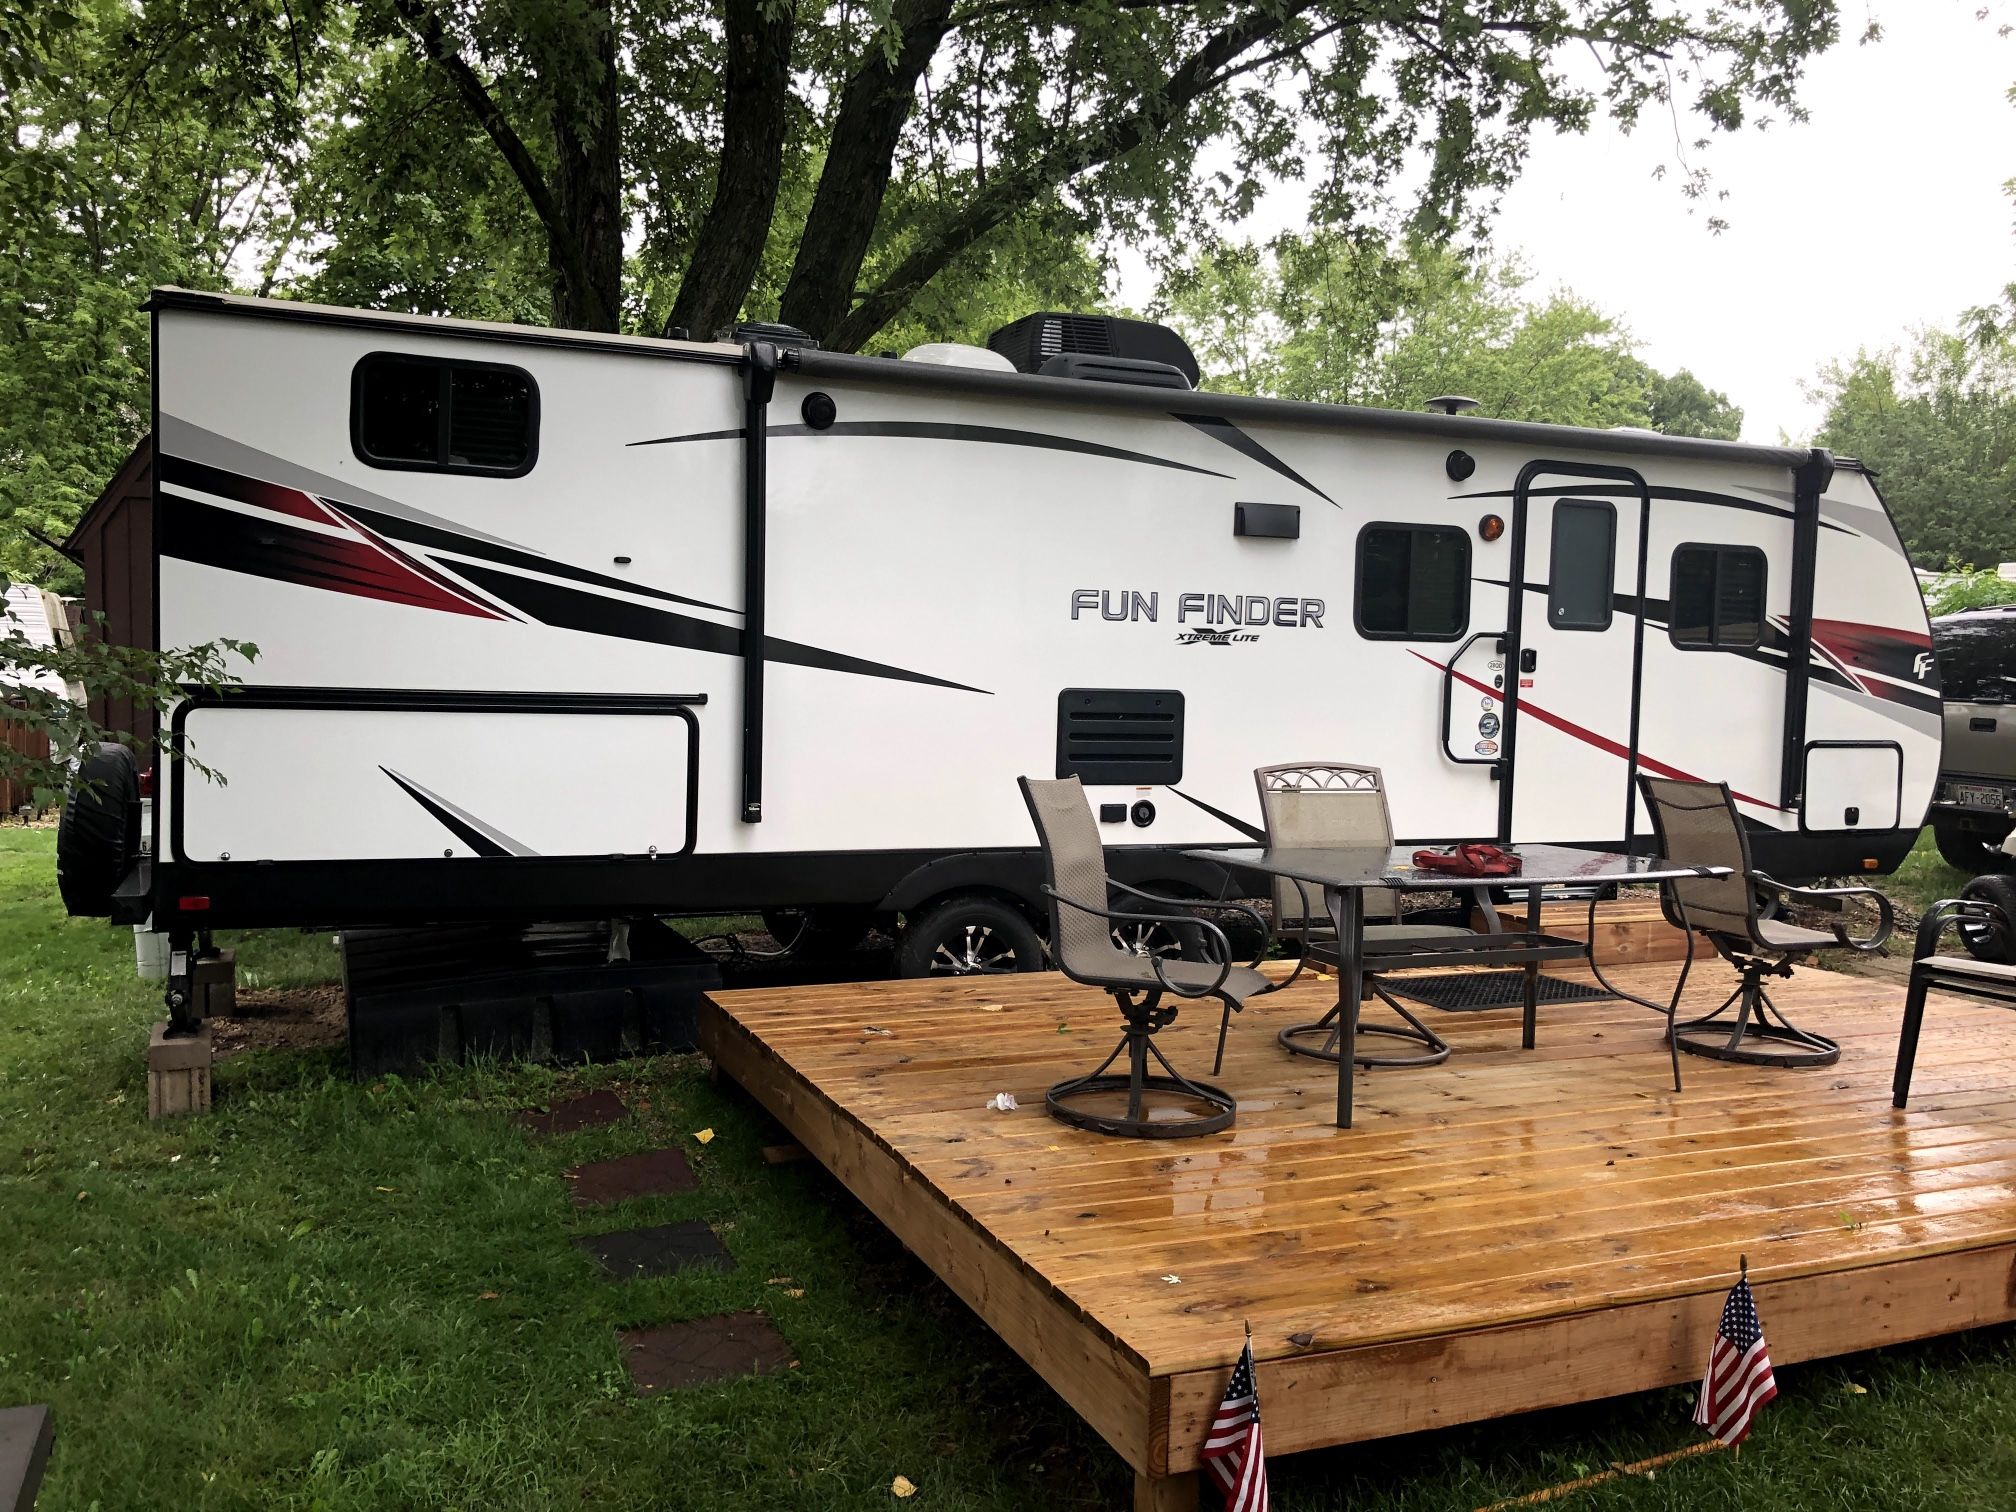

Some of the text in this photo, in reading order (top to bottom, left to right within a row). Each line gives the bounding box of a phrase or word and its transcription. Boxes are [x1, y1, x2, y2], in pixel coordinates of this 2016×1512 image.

[1071, 589, 1325, 628] FUN FINDER
[1175, 630, 1260, 643] XTREME LITE
